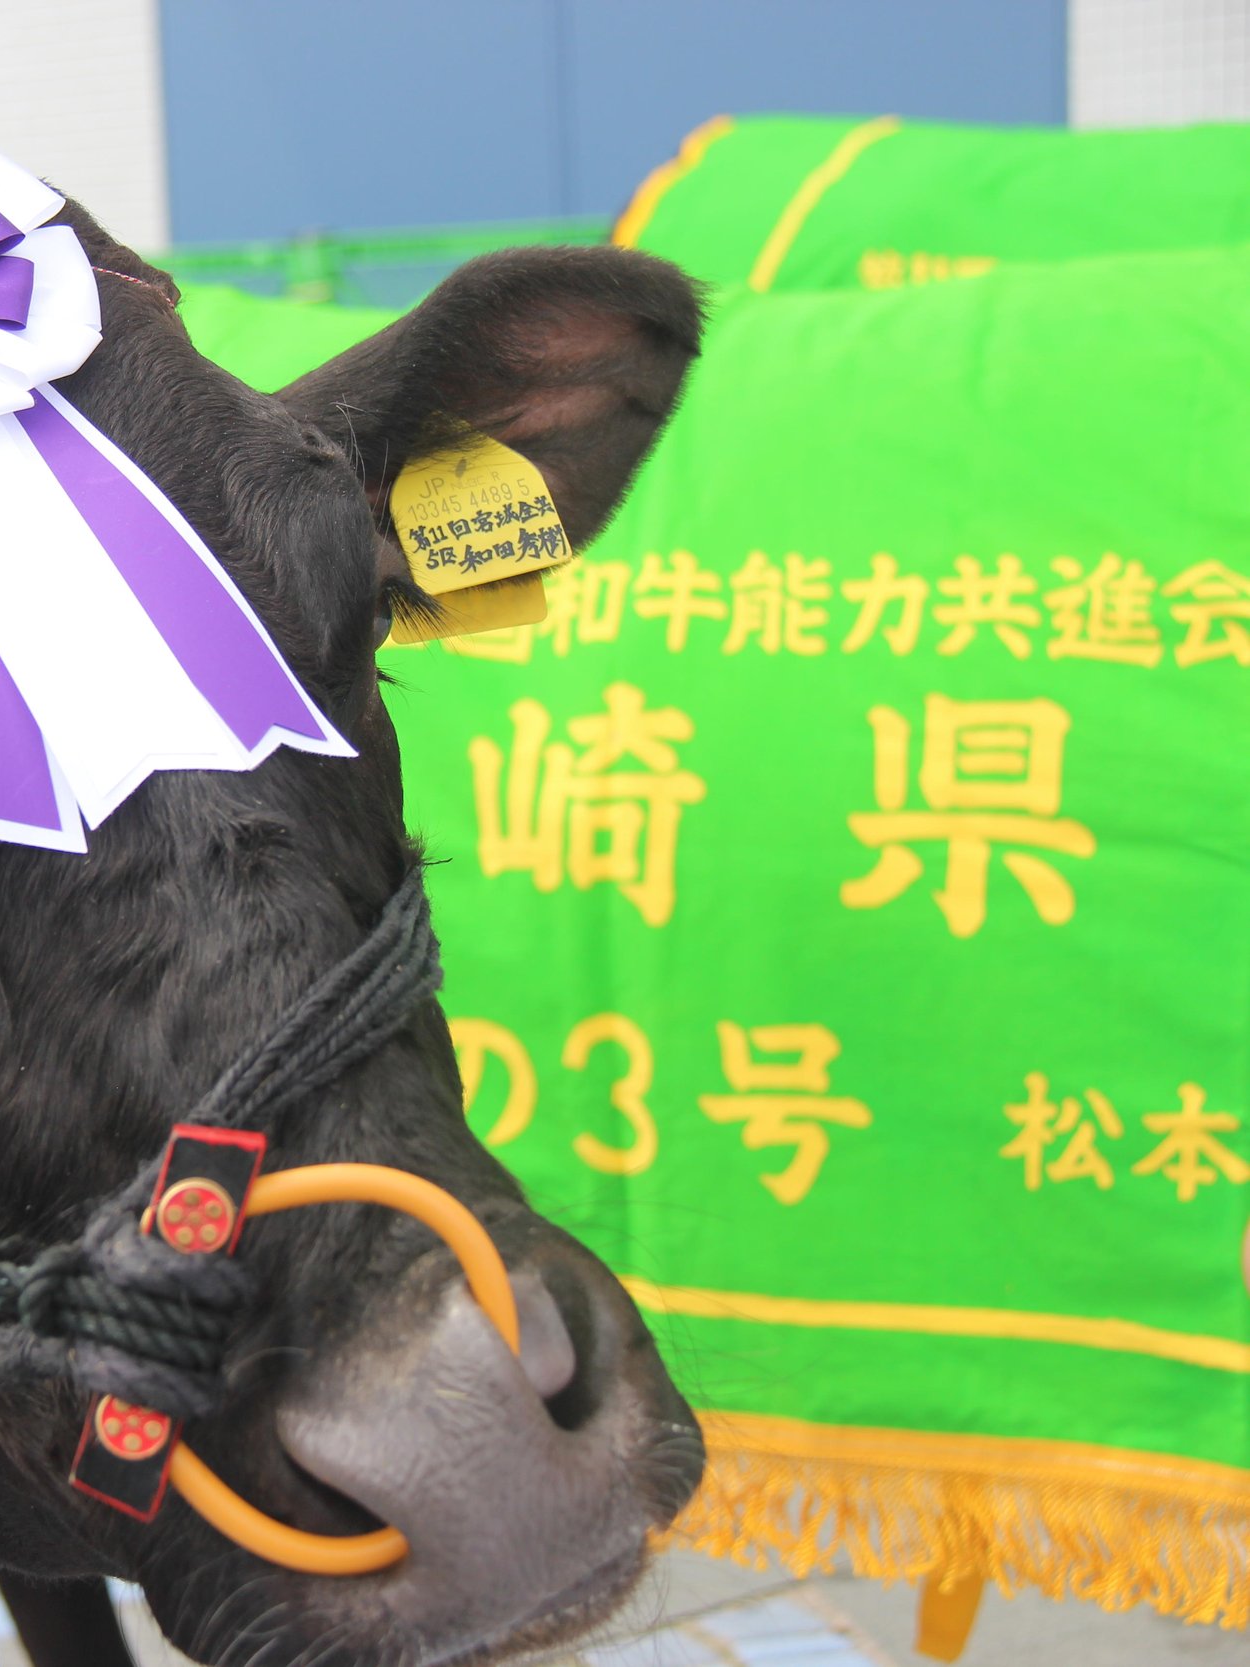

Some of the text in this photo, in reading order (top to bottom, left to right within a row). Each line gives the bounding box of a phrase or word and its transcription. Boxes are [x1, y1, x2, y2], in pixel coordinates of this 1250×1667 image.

[407, 478, 530, 523] 13345 4489 5
[418, 476, 445, 499] JP
[390, 549, 1250, 668] 和牛能力共進会
[999, 1071, 1250, 1202] 松本
